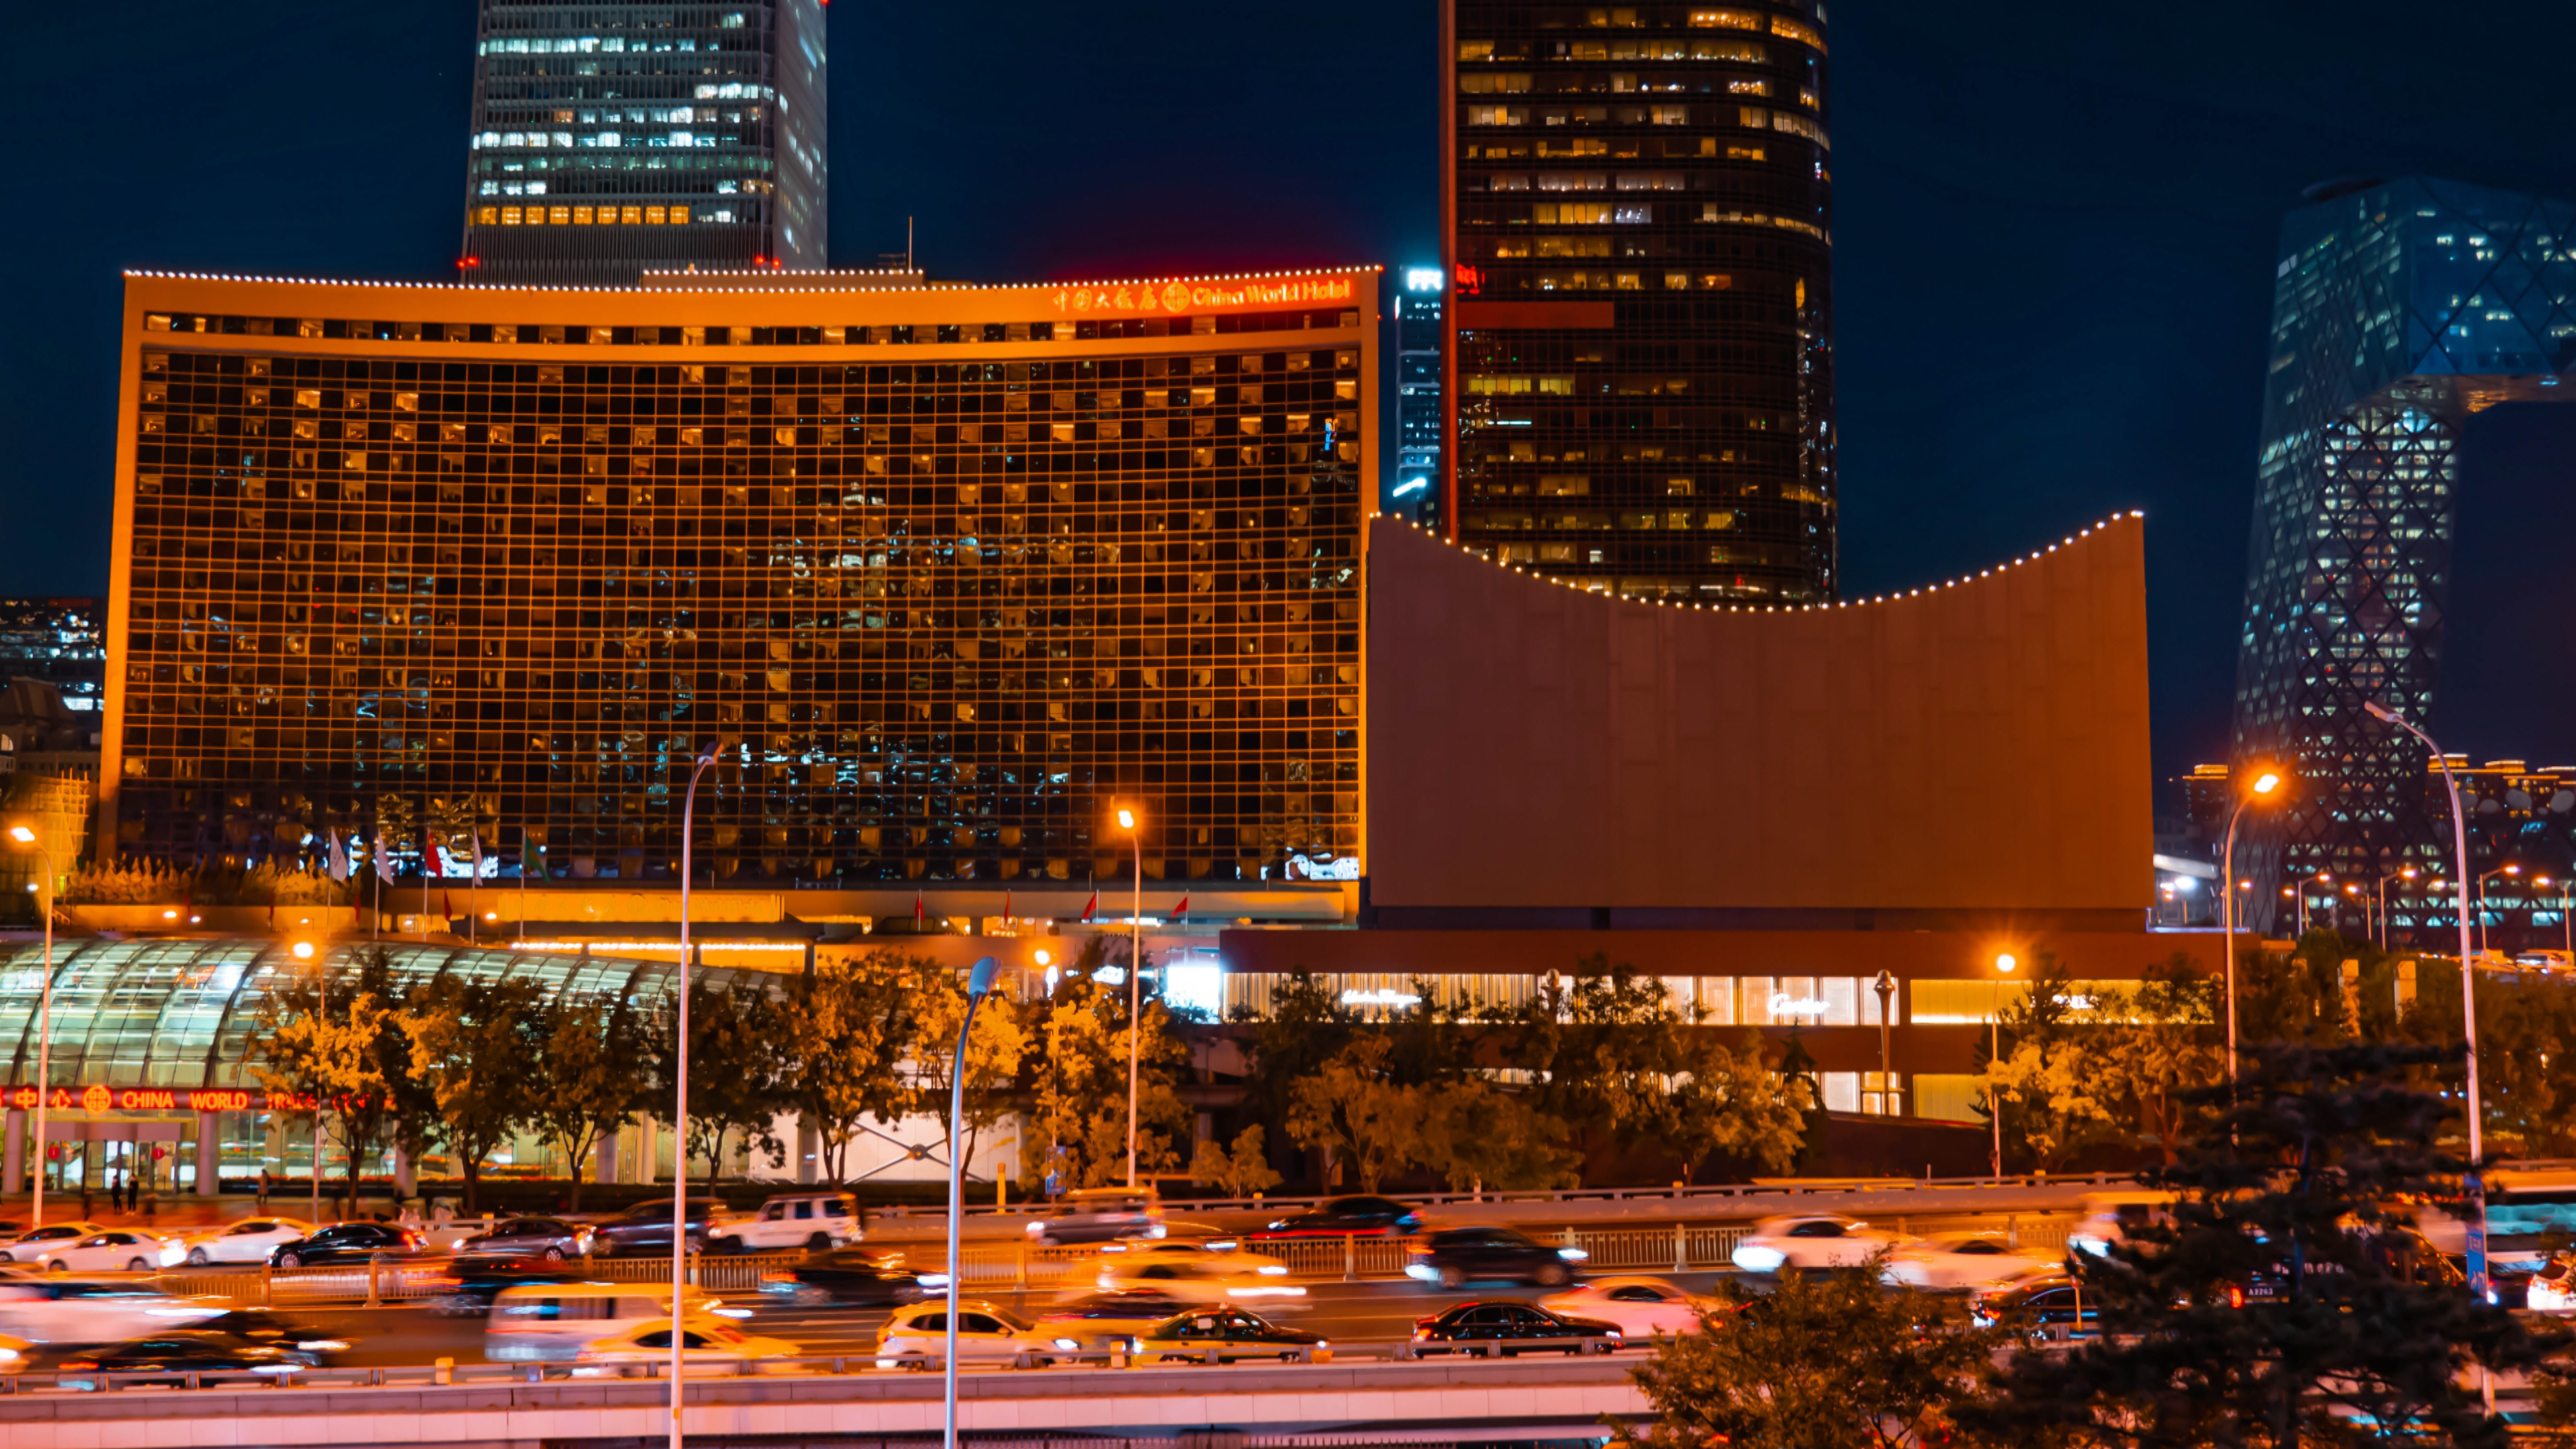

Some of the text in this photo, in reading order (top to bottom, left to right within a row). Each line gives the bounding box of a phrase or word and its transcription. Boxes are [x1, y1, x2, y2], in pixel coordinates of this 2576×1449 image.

[1193, 278, 1350, 307] China World Hotel
[0, 1087, 72, 1111] 中心
[123, 1091, 175, 1108] CHINA
[189, 1091, 248, 1110] WORLD
